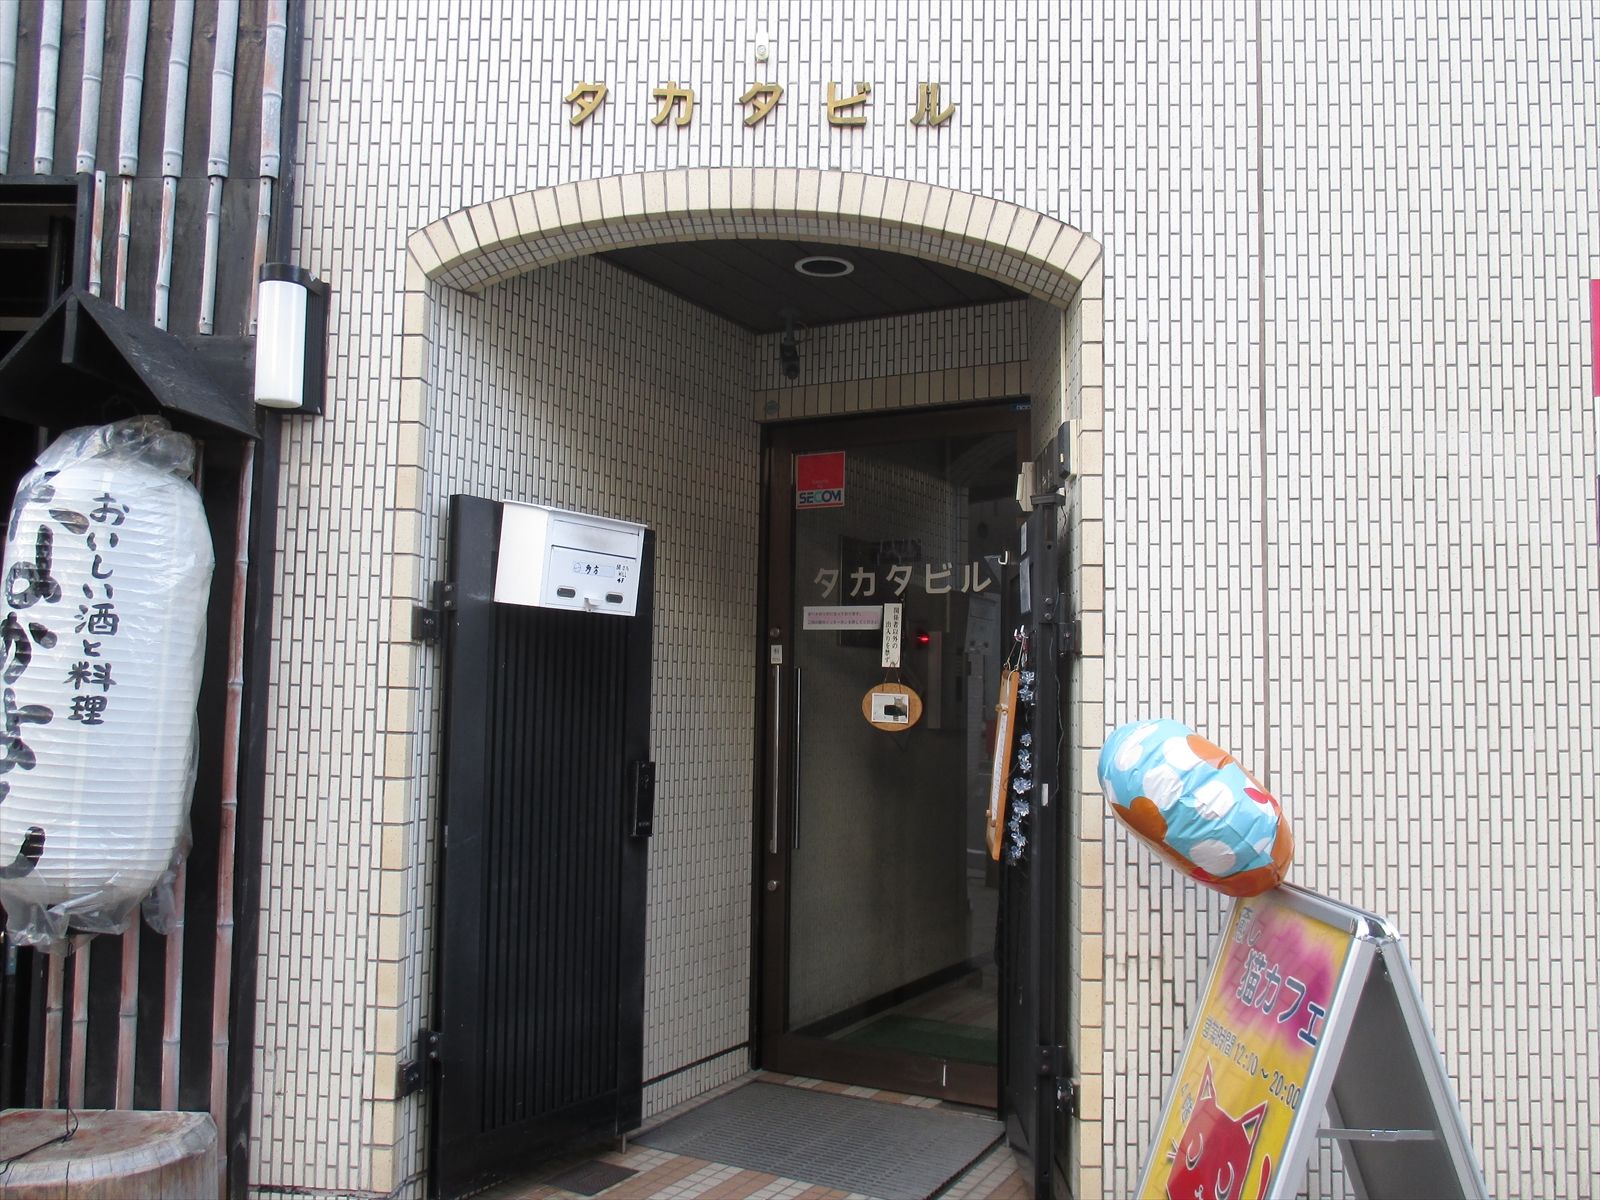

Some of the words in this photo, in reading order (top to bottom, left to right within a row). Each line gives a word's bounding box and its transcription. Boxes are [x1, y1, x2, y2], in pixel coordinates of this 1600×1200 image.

[564, 80, 957, 128] タカタビル
[799, 489, 842, 504] SECOM
[813, 561, 992, 599] タカタビル
[64, 492, 129, 725] おいしい酒と料理
[1235, 947, 1326, 1048] 猫カフェ
